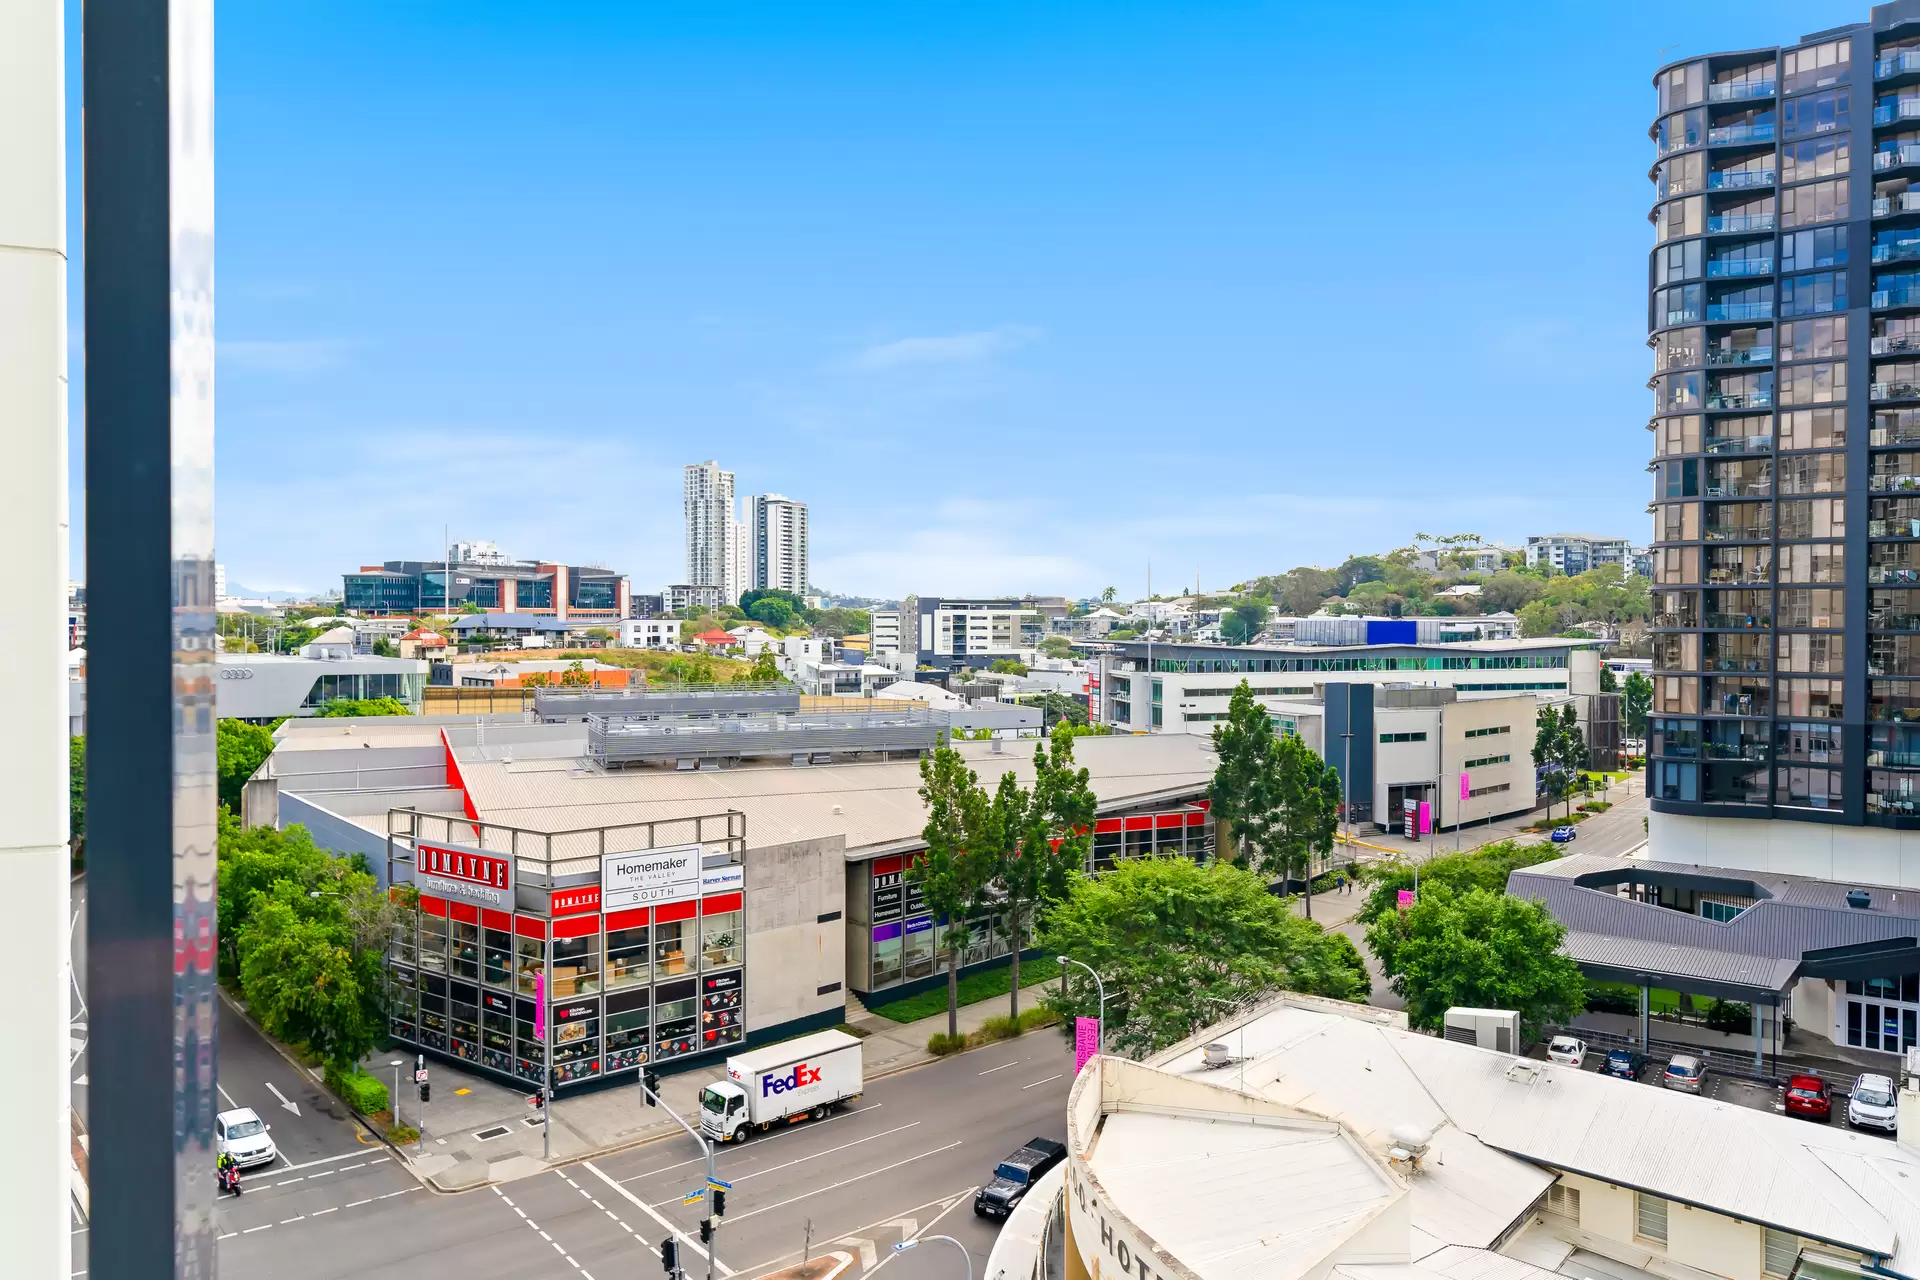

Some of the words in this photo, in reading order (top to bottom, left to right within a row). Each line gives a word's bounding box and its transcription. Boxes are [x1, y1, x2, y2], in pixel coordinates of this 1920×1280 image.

[420, 849, 503, 886] DOMAYNE
[617, 858, 687, 875] Homemaker
[648, 872, 676, 880] VALLEY
[875, 873, 903, 889] DOMA
[426, 877, 457, 893] furniture
[460, 884, 466, 896] &
[467, 885, 500, 905] bedding
[633, 888, 674, 901] SOUTH
[878, 893, 897, 901] Furniture
[555, 894, 599, 908] DOMAYNE
[875, 908, 900, 917] Homewares
[1087, 1022, 1096, 1058] FESTIV
[762, 1063, 822, 1098] FedEx
[797, 1085, 820, 1096] Express
[1101, 1215, 1164, 1280] HOT
